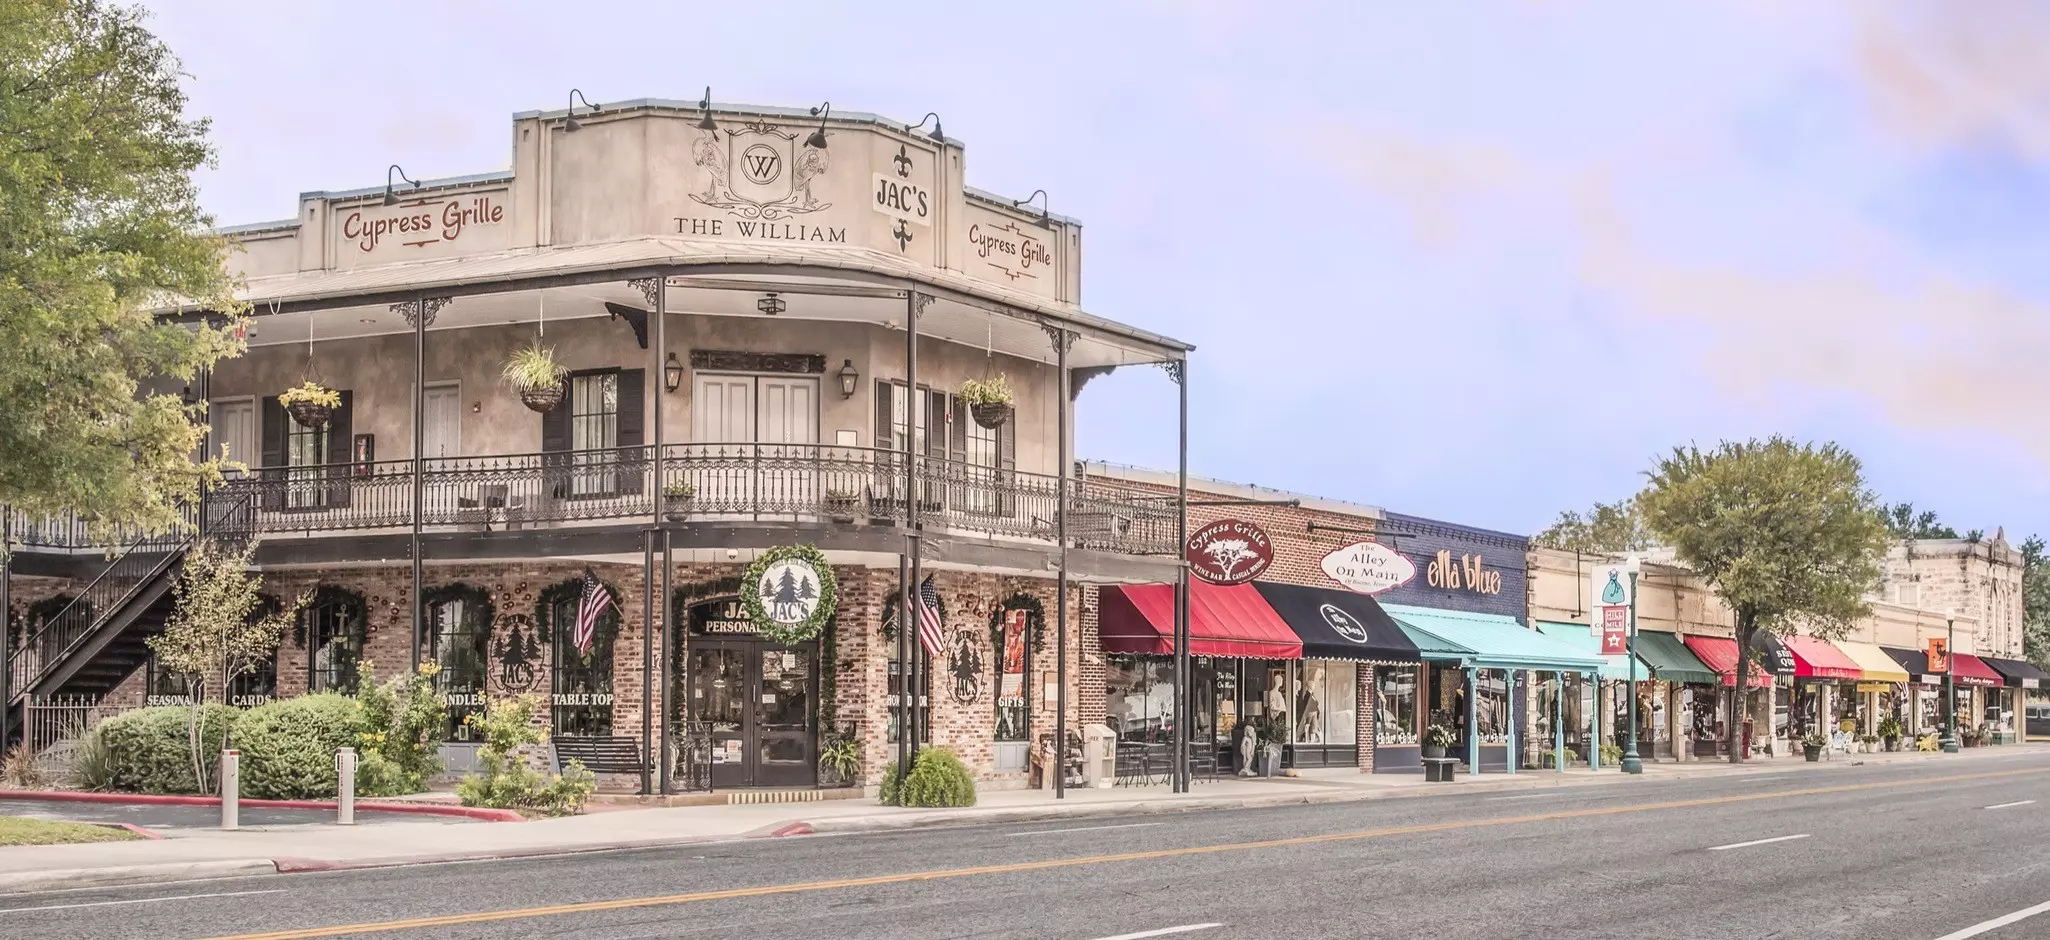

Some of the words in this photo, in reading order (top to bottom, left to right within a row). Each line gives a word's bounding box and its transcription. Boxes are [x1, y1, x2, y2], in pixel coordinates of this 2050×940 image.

[746, 155, 777, 178] W
[877, 179, 928, 217] JAC'S
[344, 212, 432, 252] Cypress
[442, 197, 504, 241] Grille
[674, 217, 723, 236] THE
[736, 220, 846, 243] WILLIAM
[969, 223, 1016, 258] Cypress
[1021, 240, 1051, 268] Grille
[1190, 523, 1229, 550] Cypress
[1234, 522, 1266, 548] Grille
[1193, 563, 1209, 578] WINE
[1351, 553, 1387, 567] Alley
[1336, 566, 1355, 577] On
[1361, 568, 1399, 582] Main
[1427, 549, 1461, 590] ella
[1462, 553, 1501, 595] blue
[770, 600, 810, 620] JAC'S
[500, 662, 534, 686] JAC'S
[146, 694, 191, 706] SEASONA
[231, 694, 272, 706] CARDS
[552, 693, 589, 706] TABLE
[591, 693, 614, 706] TOP
[998, 695, 1025, 707] GIFTS
